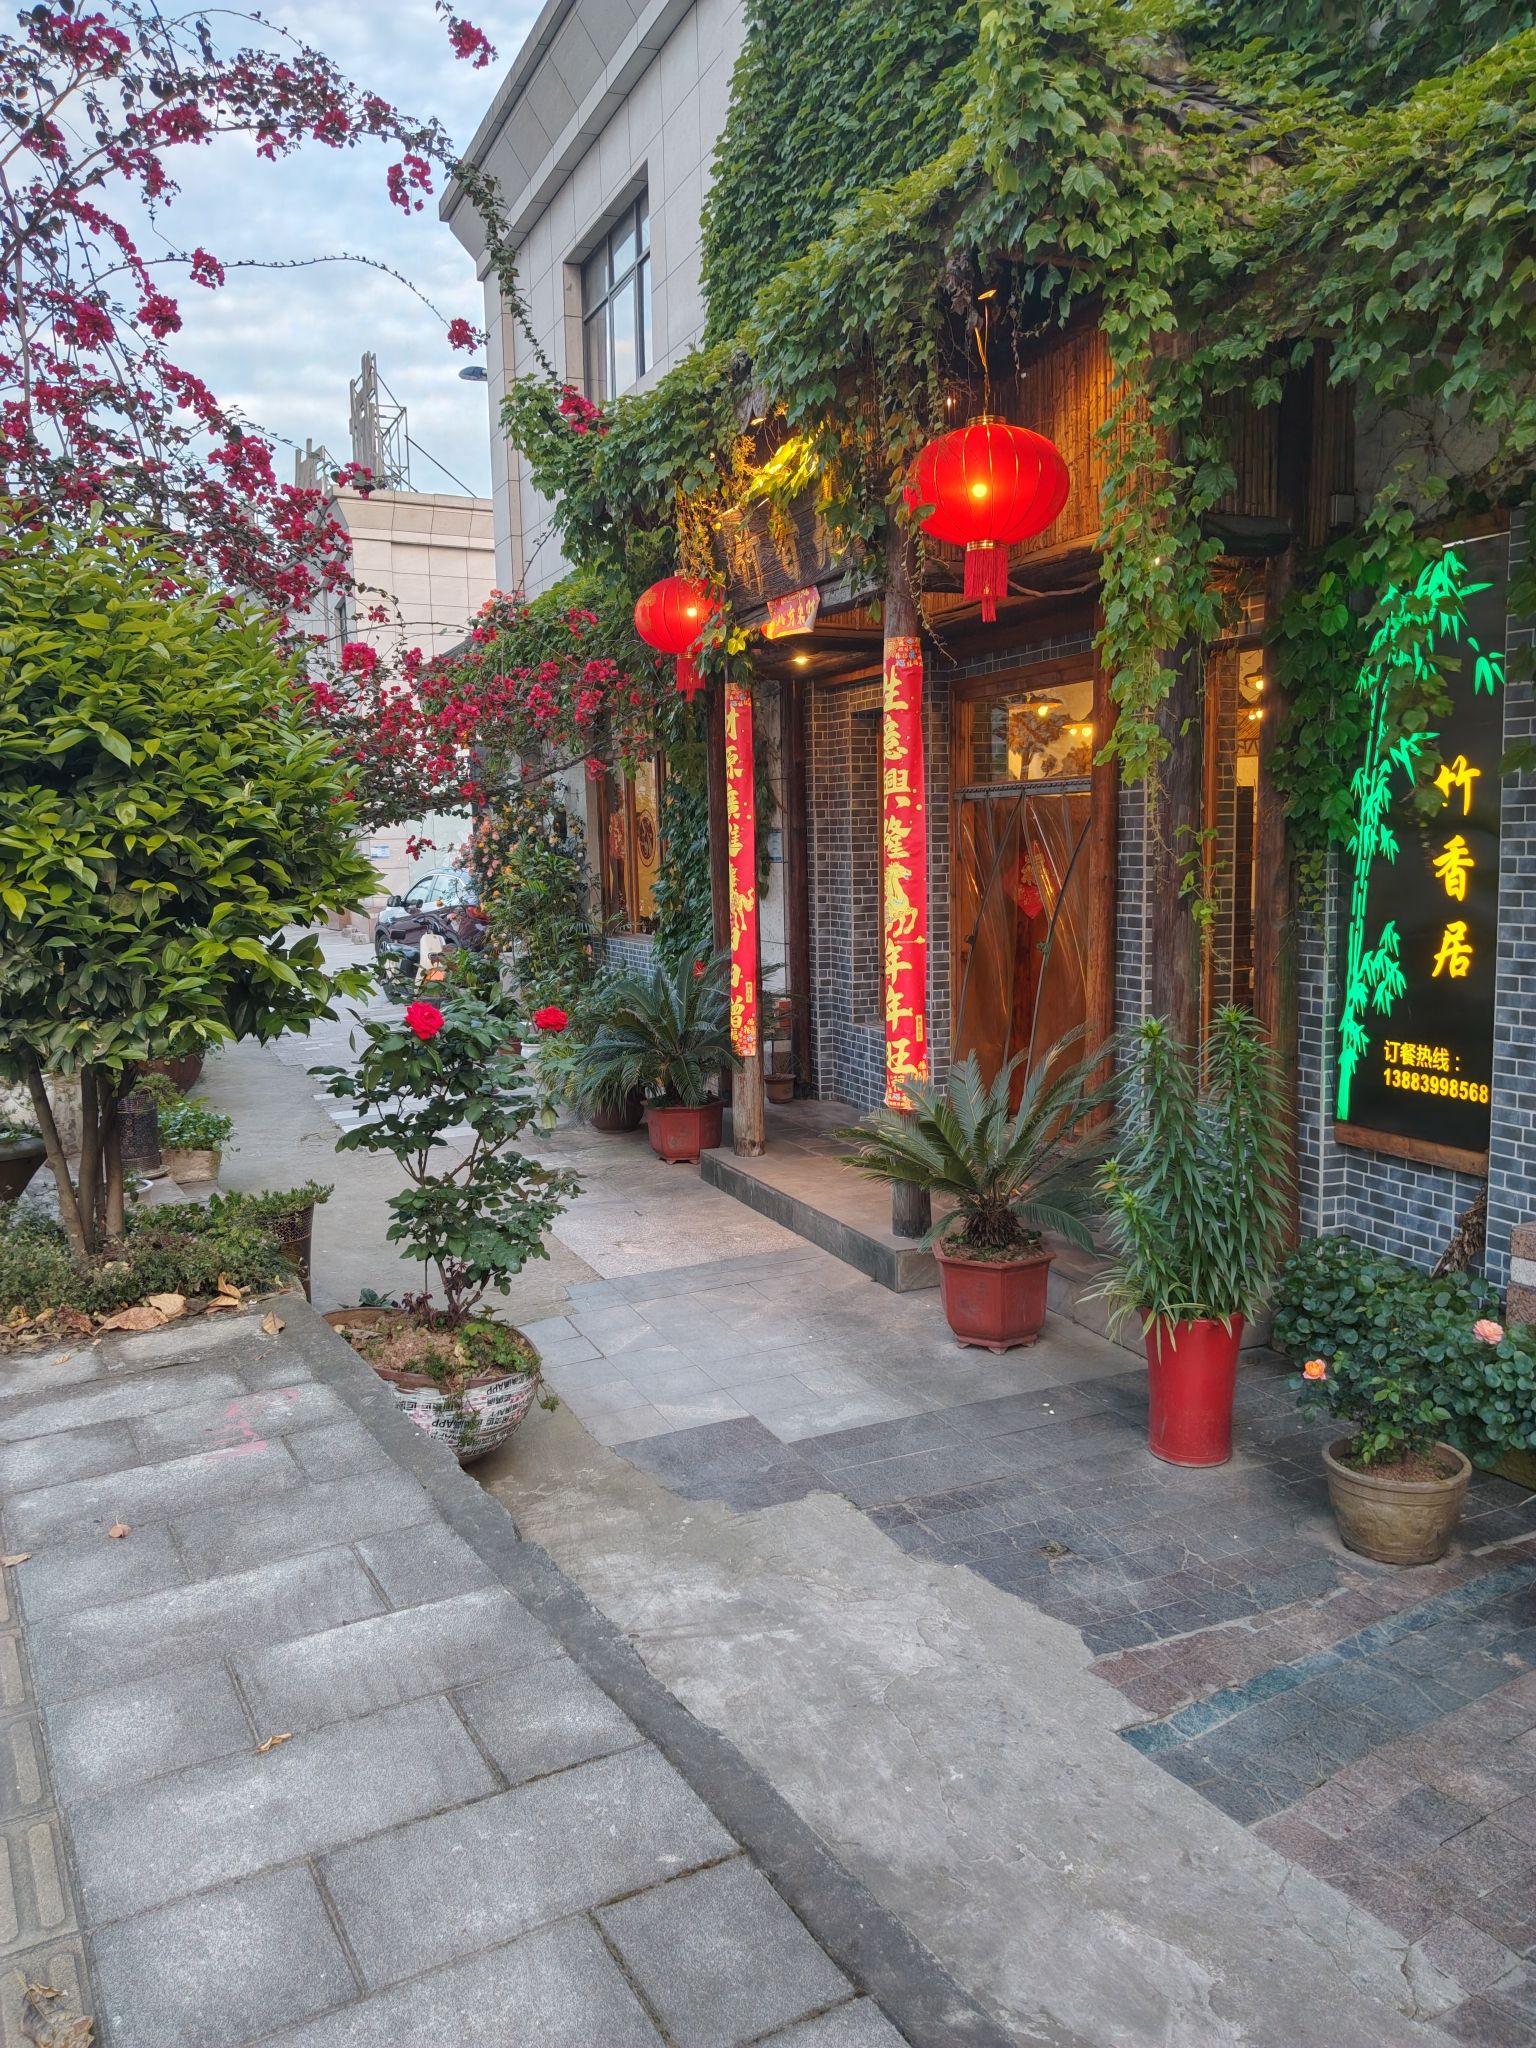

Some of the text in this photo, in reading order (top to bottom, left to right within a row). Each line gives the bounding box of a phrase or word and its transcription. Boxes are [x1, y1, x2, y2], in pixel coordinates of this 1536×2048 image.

[1431, 754, 1481, 979] 竹香居
[1383, 1040, 1460, 1072] 订餐热线：
[1383, 1067, 1489, 1104] 13883998568
